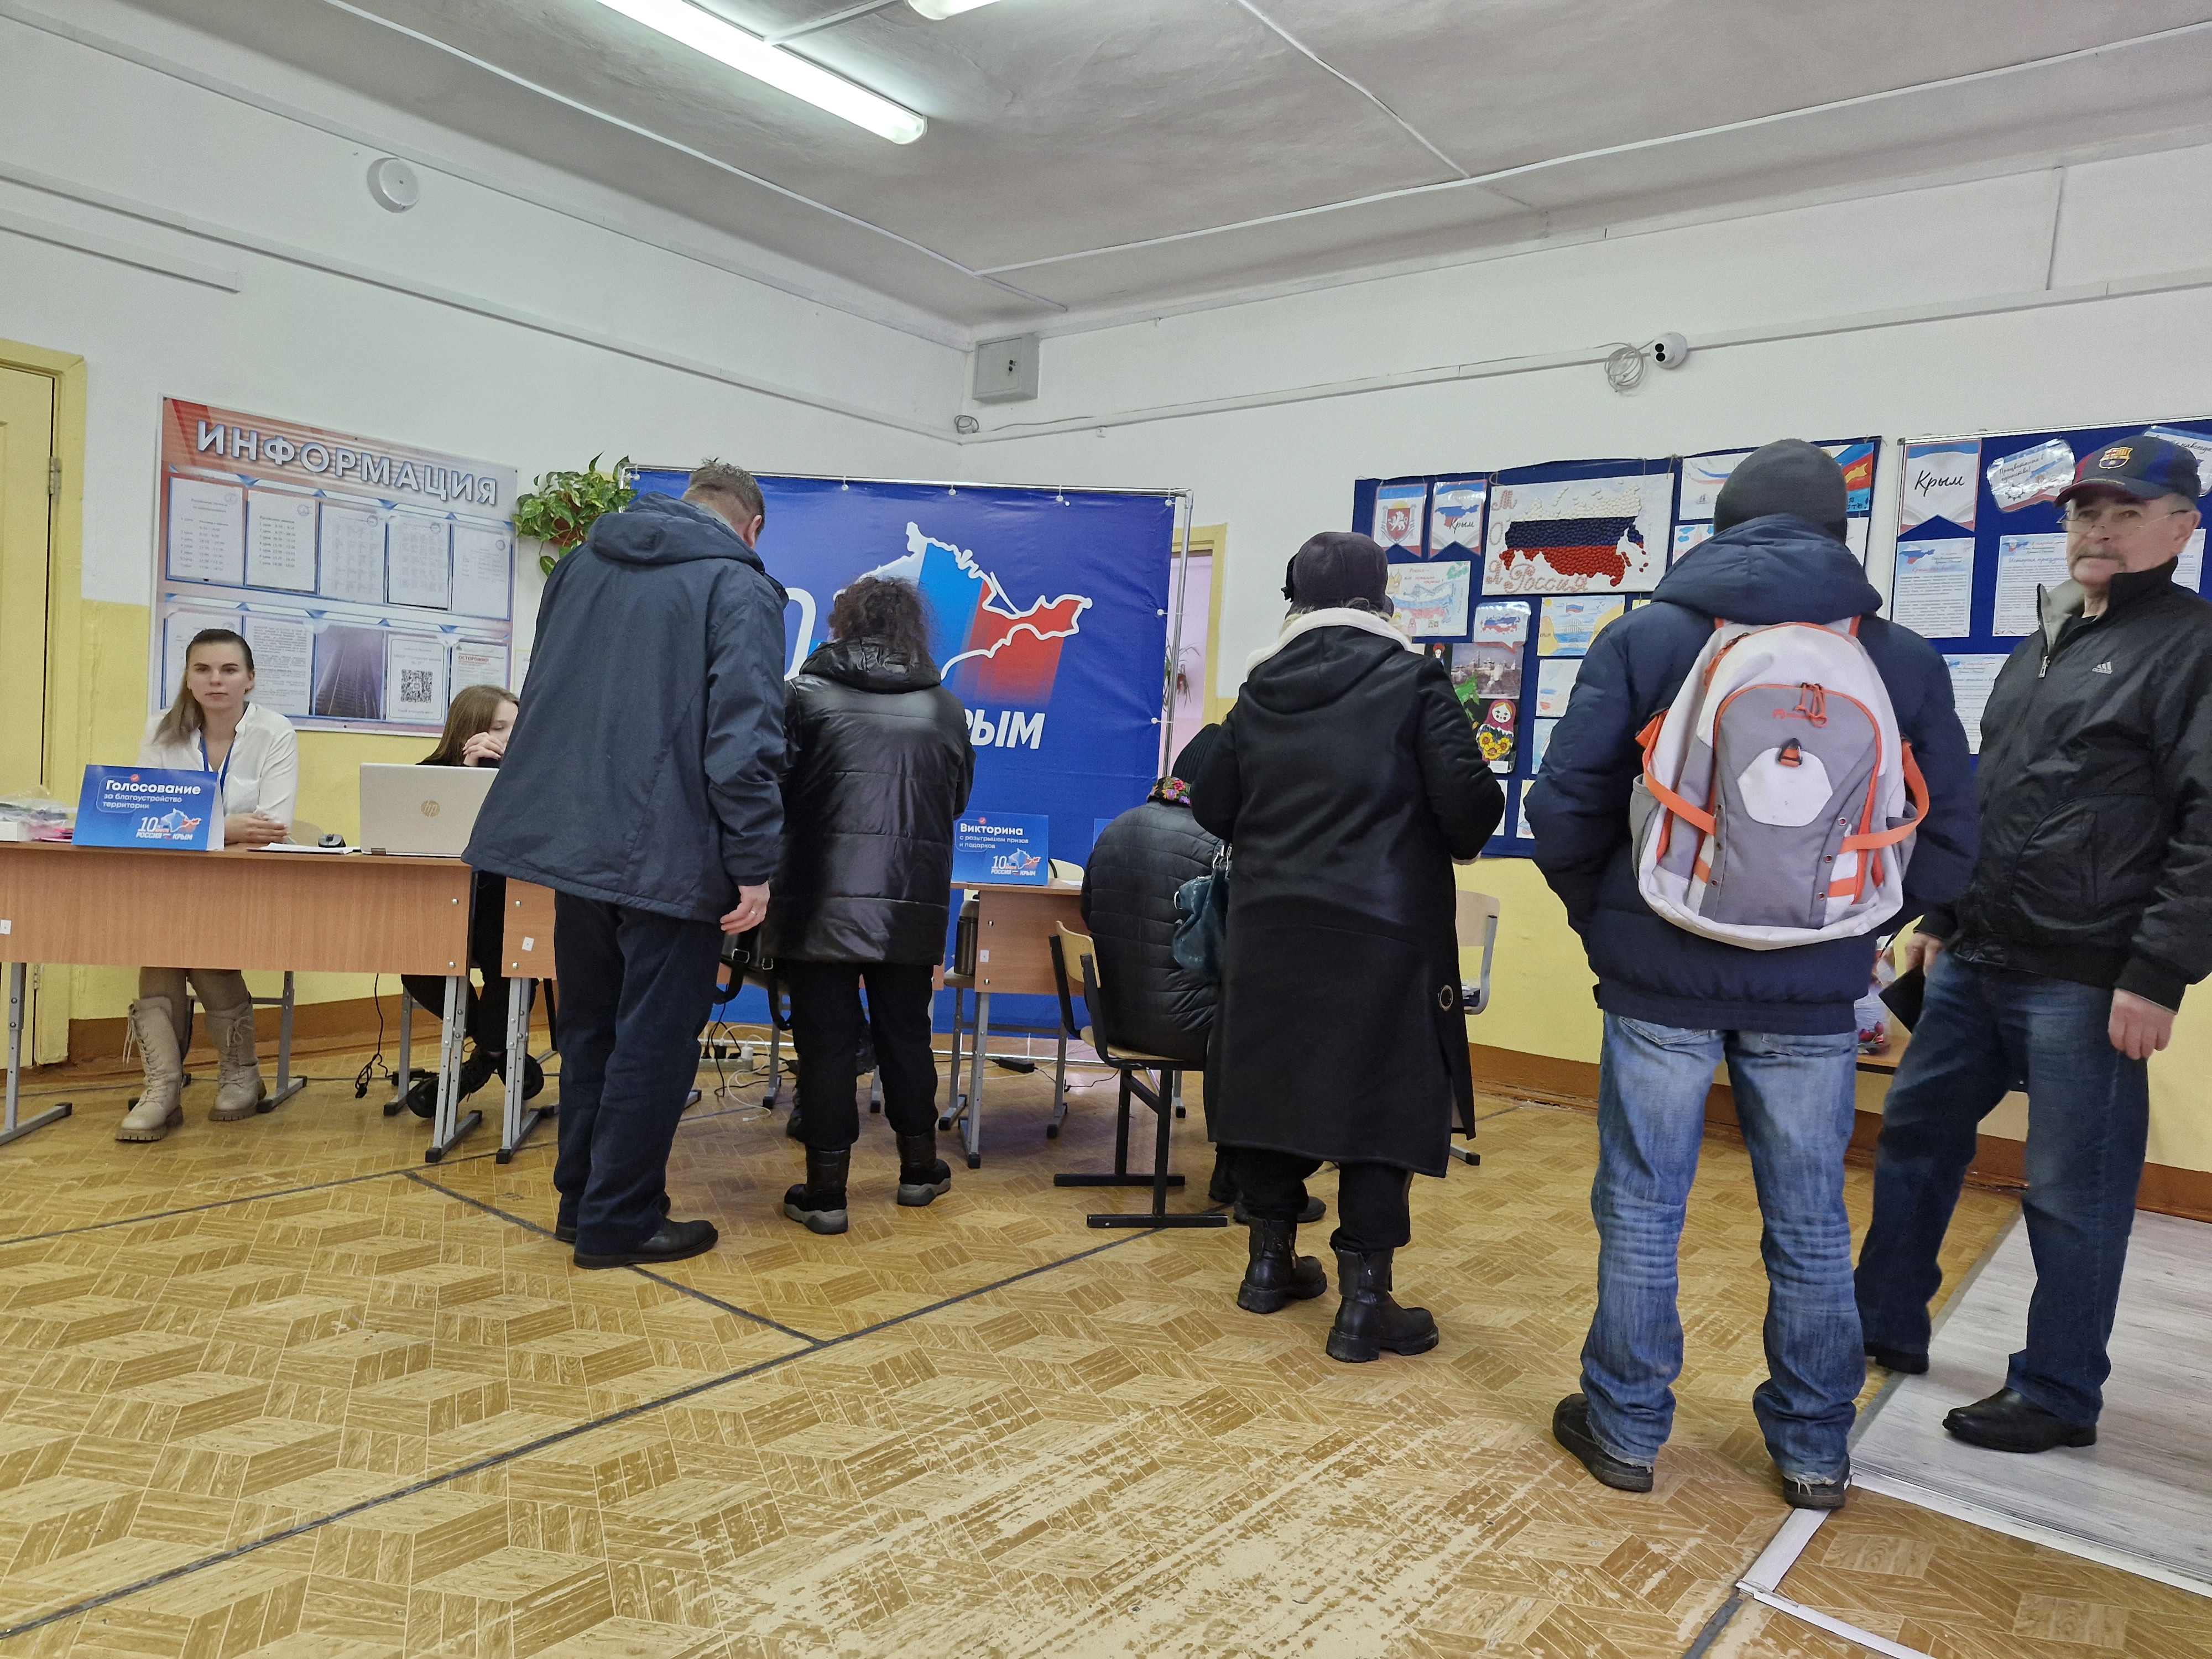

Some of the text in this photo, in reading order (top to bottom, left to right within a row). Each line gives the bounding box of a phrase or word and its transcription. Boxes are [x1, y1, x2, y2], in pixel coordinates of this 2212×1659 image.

[197, 419, 497, 505] ИНФОРМАЦИЯ
[1914, 469, 1965, 498] Крым
[1449, 517, 1475, 534] Крым
[1503, 563, 1589, 594] Россия
[105, 779, 202, 795] Голосование
[114, 793, 183, 803] благоустройство
[424, 800, 438, 818] hp
[137, 816, 159, 832] 10
[959, 823, 1024, 836] Викторина
[991, 855, 1007, 869] 10
